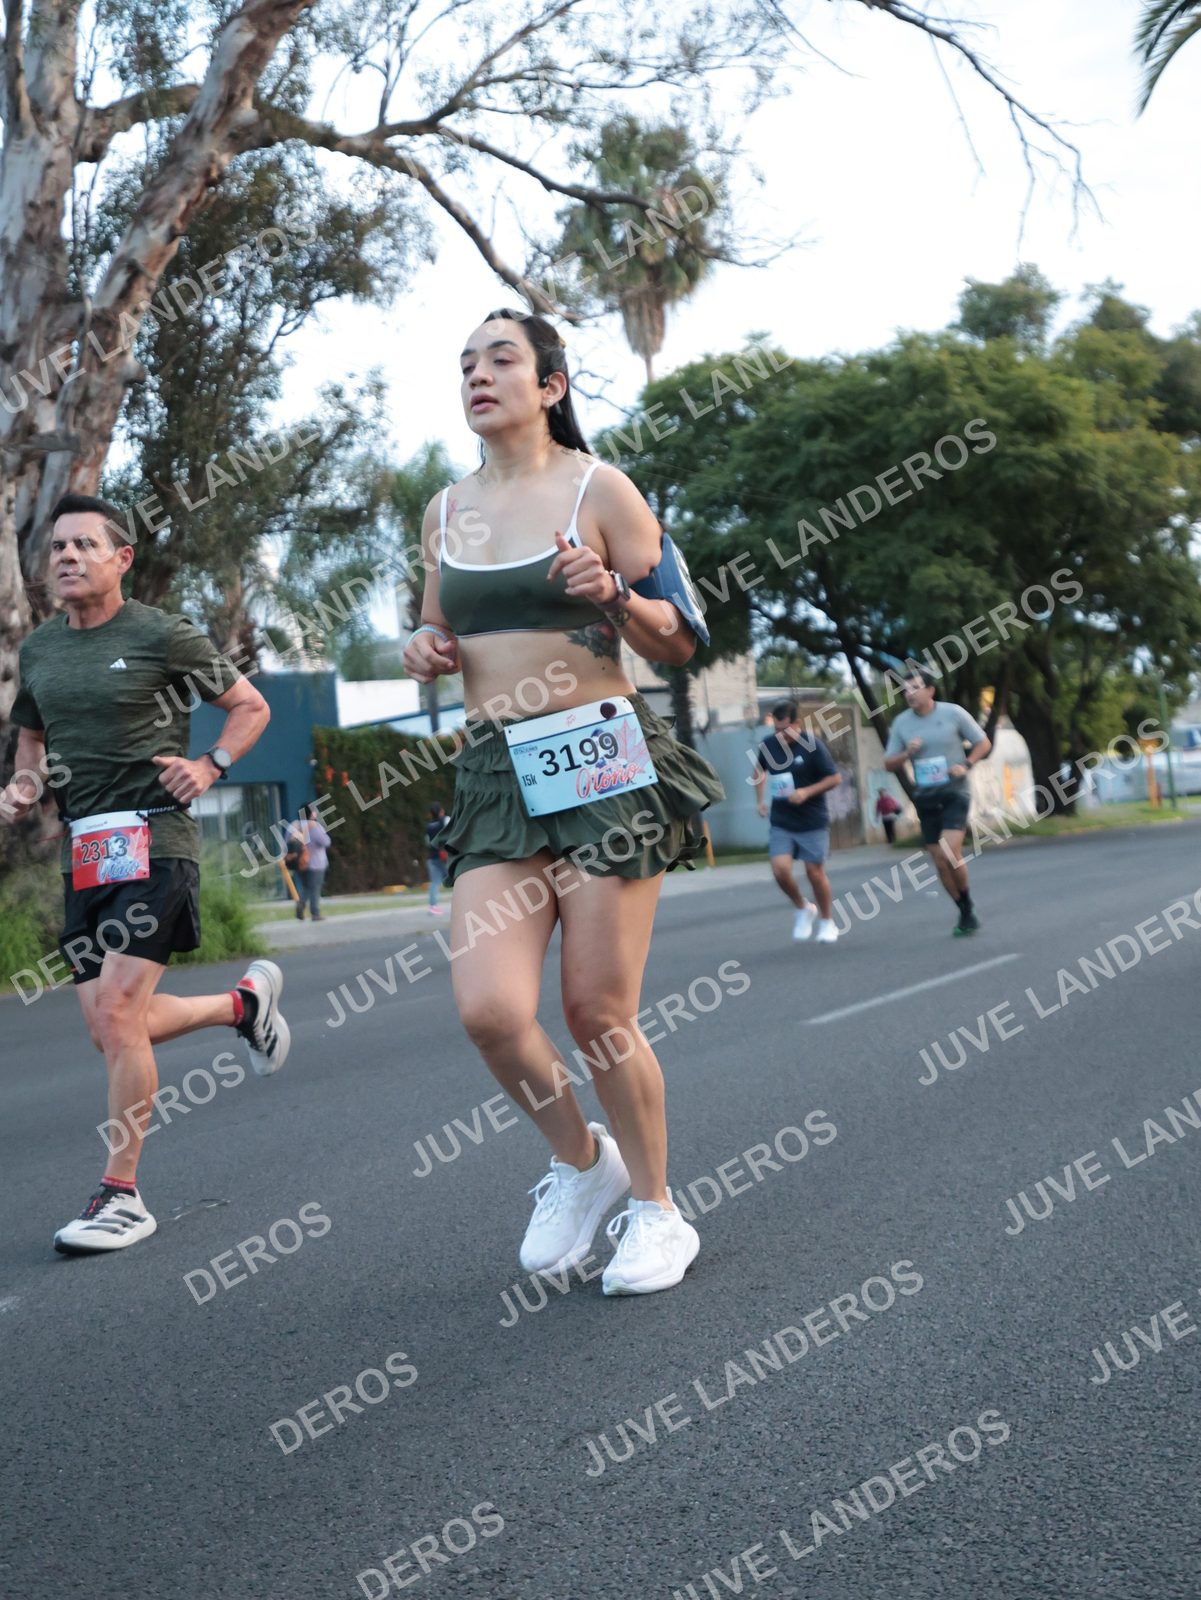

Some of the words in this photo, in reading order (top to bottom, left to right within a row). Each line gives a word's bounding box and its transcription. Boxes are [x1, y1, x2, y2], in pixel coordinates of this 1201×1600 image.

[538, 732, 619, 777] 3199
[522, 773, 538, 788] 15k
[81, 836, 129, 865] 2313
